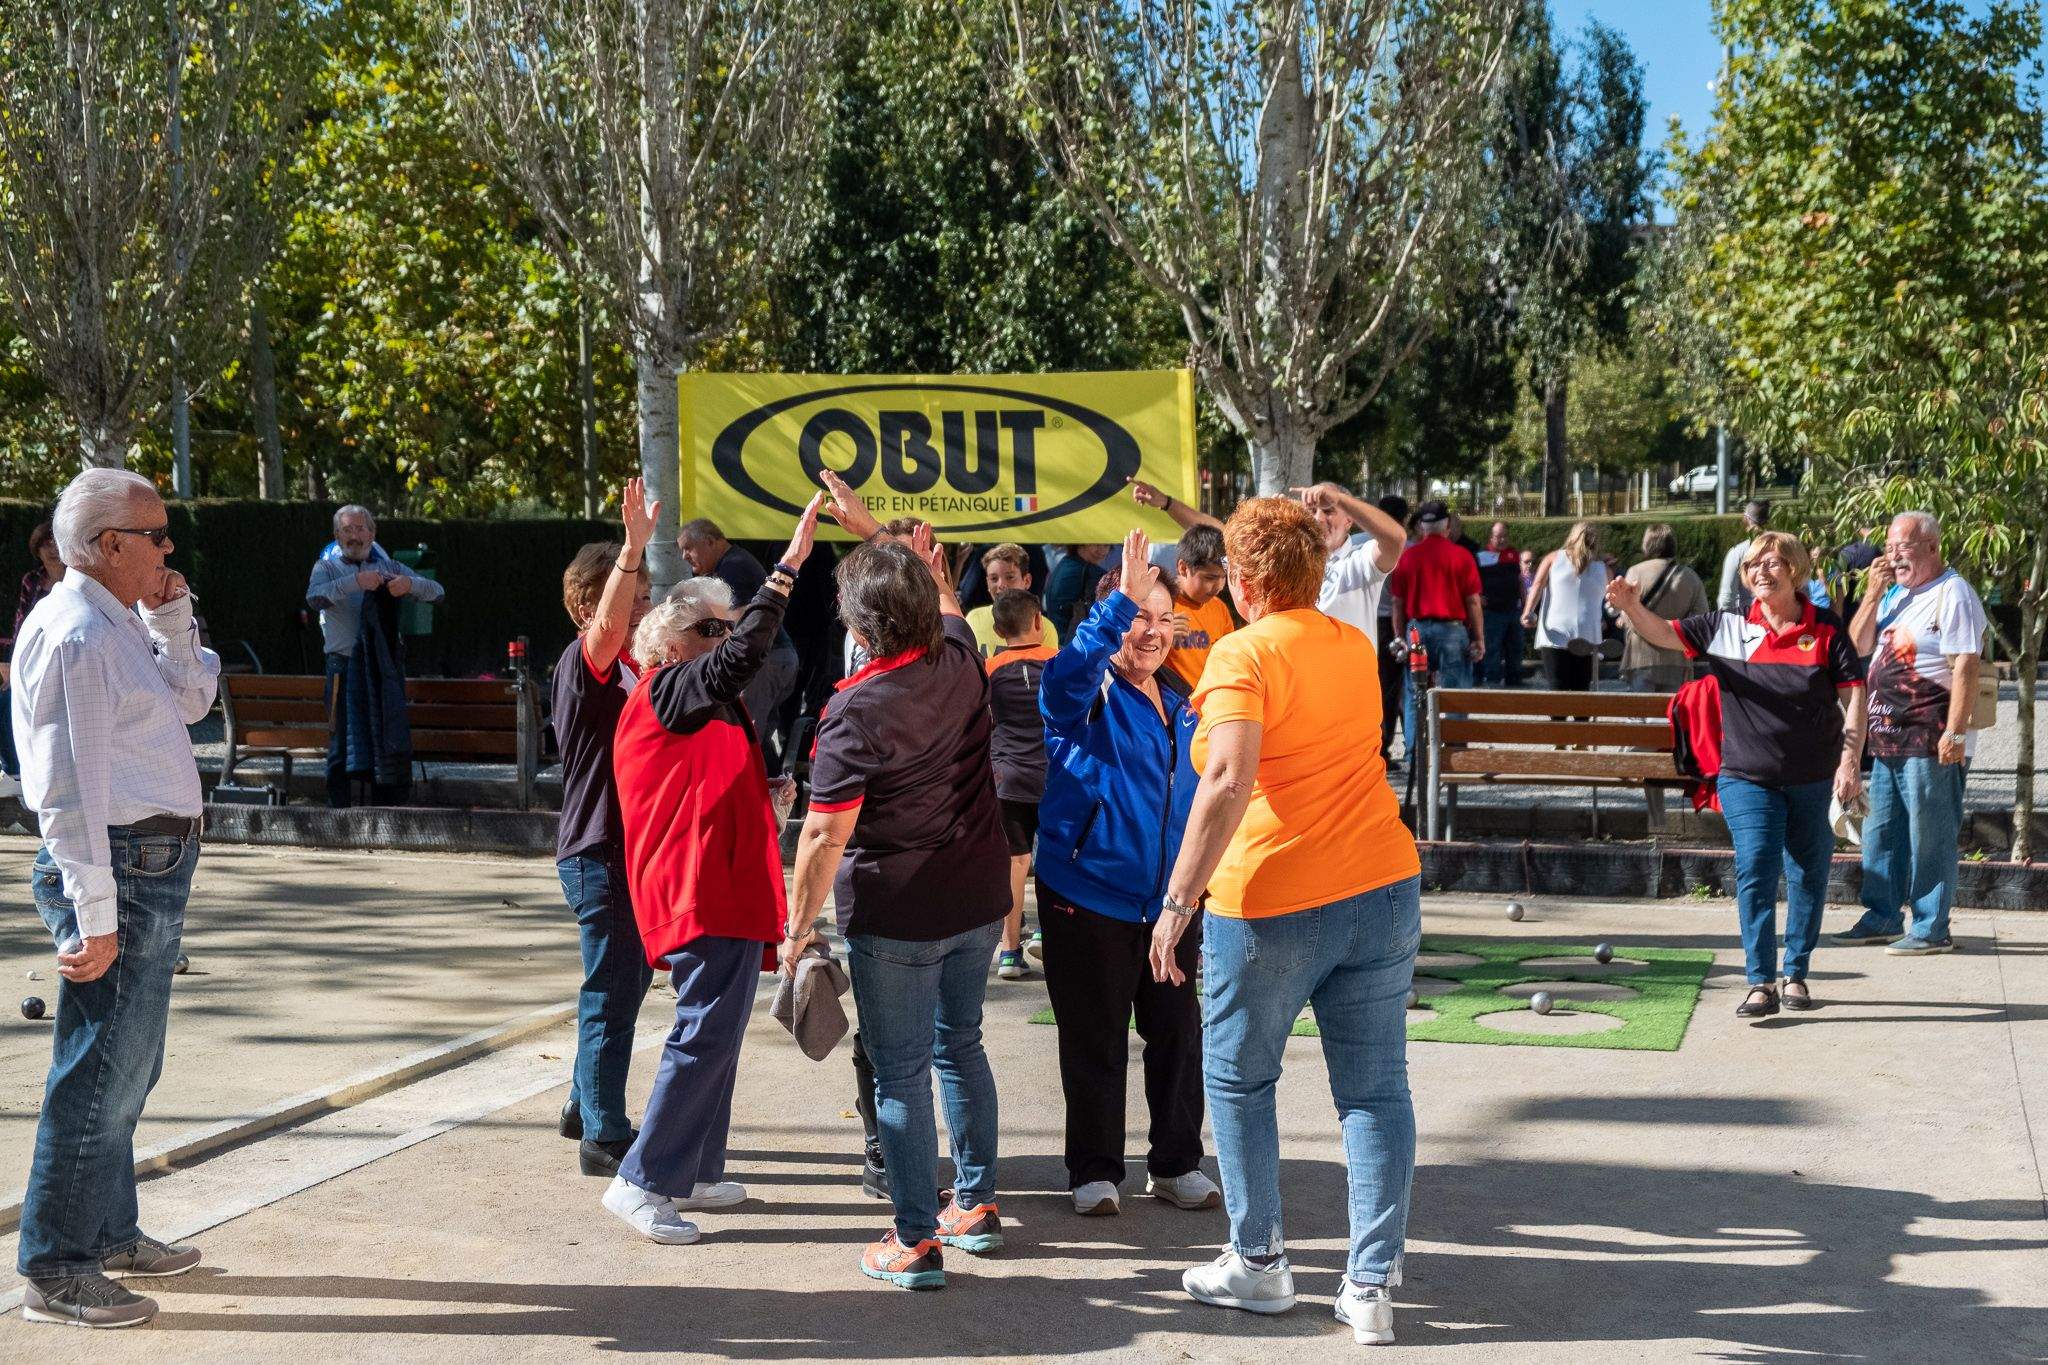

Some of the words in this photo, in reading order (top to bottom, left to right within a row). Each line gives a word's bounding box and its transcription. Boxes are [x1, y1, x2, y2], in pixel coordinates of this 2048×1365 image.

[798, 408, 1045, 495] OBUT
[893, 497, 914, 511] EN
[920, 493, 1010, 512] PÉTANQUE
